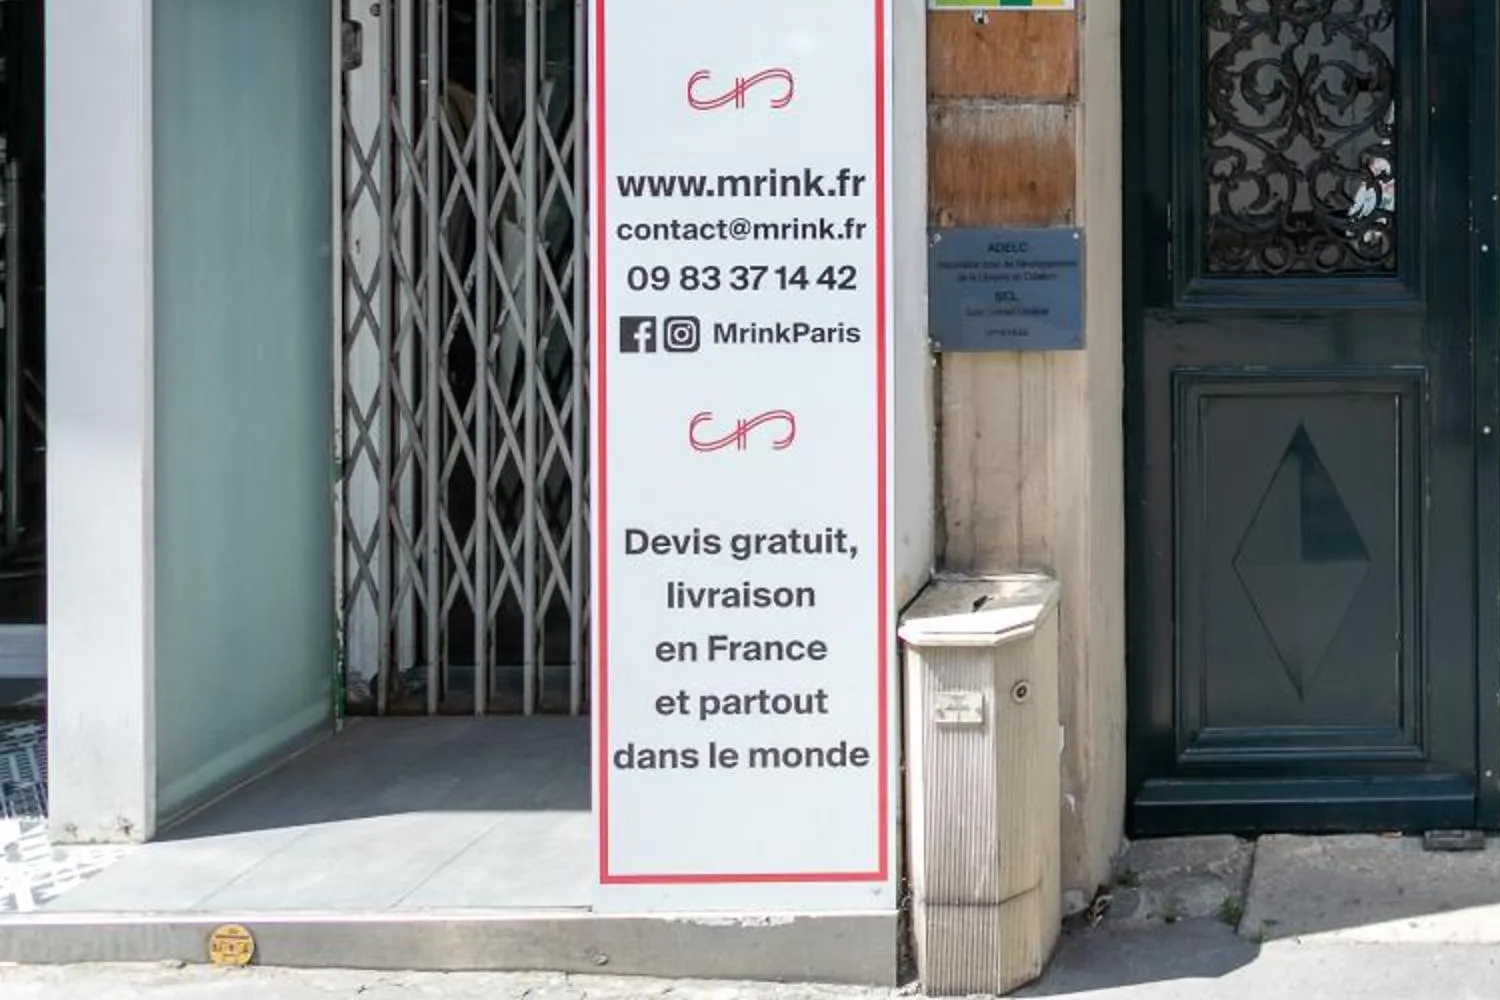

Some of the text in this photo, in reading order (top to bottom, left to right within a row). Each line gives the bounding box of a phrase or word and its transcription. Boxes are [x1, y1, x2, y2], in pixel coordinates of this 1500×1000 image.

[617, 168, 865, 196] www.mrink.fr
[617, 218, 866, 240] contact@mrink.fr
[628, 266, 856, 290] 09 83 37 14 42
[714, 323, 860, 343] MrinkParis
[626, 528, 857, 560] Devis gratuit,
[668, 582, 814, 608] livraison
[656, 635, 827, 662] en France
[656, 689, 828, 720] et partout
[614, 741, 869, 769] dans le monde
